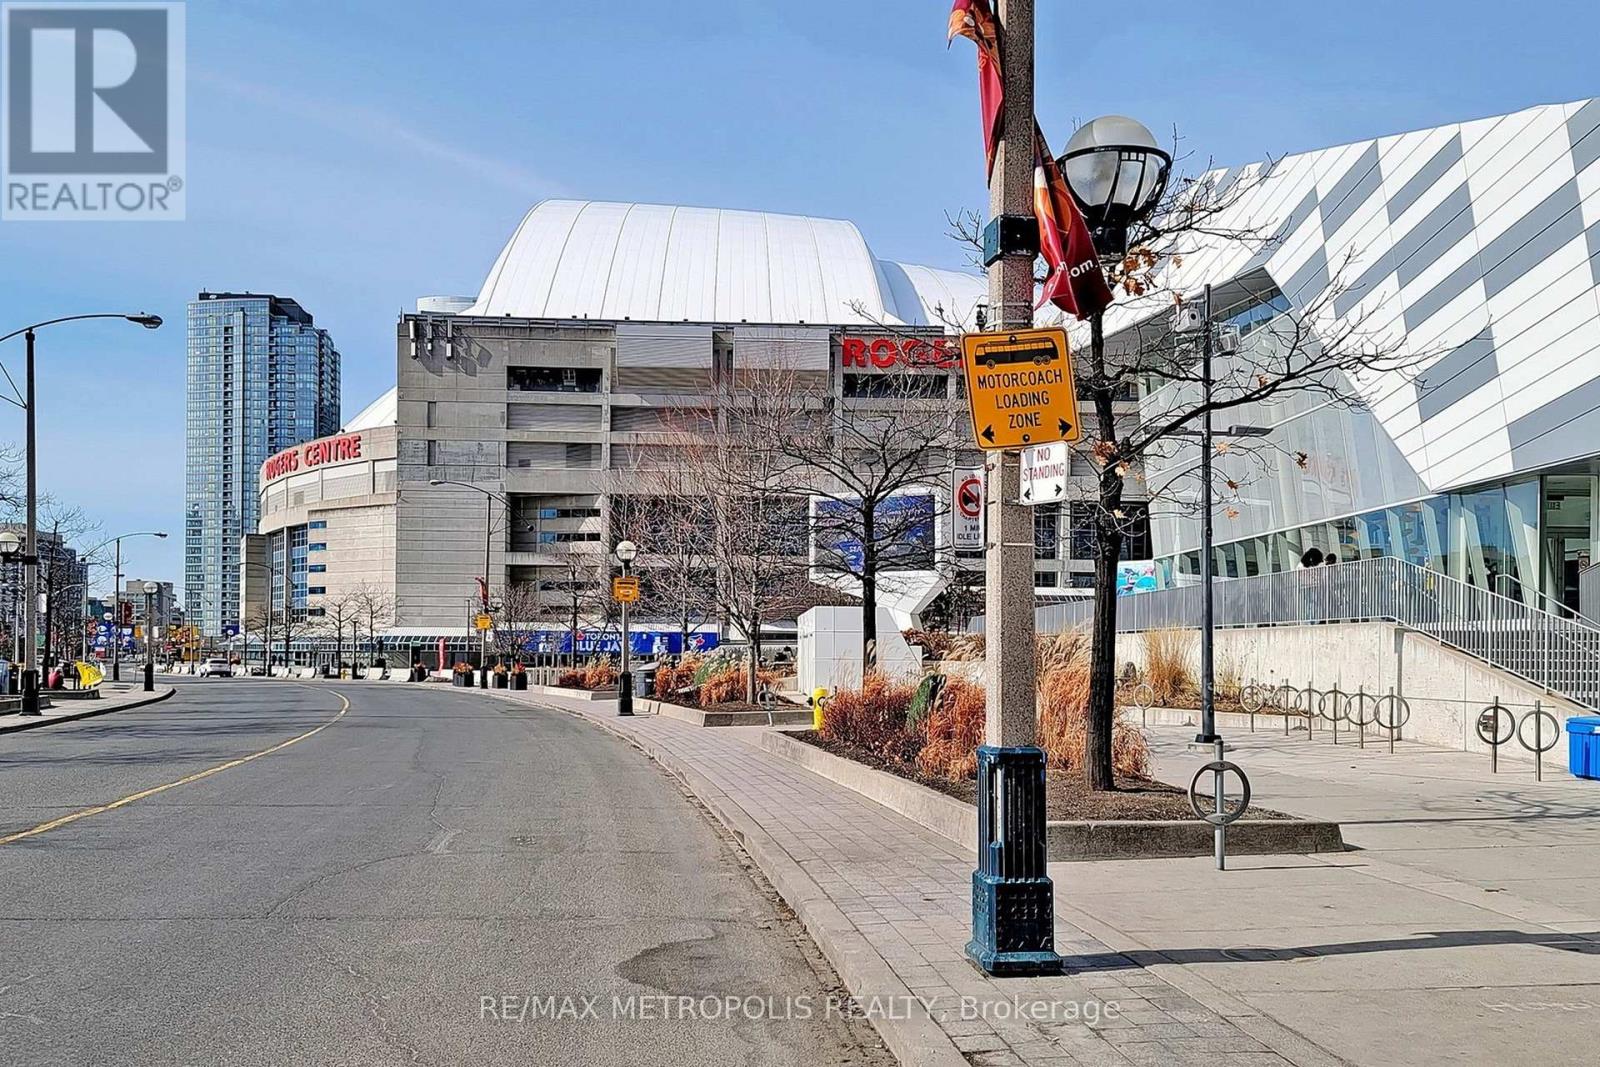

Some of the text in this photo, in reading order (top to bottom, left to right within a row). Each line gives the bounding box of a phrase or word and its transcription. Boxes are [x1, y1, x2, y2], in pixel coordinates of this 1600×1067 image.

[842, 338, 964, 368] ROGE
[977, 369, 1063, 390] MOTORCOACH
[995, 391, 1050, 409] LOADING
[1008, 412, 1042, 429] ZONE
[265, 436, 361, 480] ROGERS CENTRE
[1036, 447, 1051, 462] NO
[1022, 463, 1065, 482] STANDING
